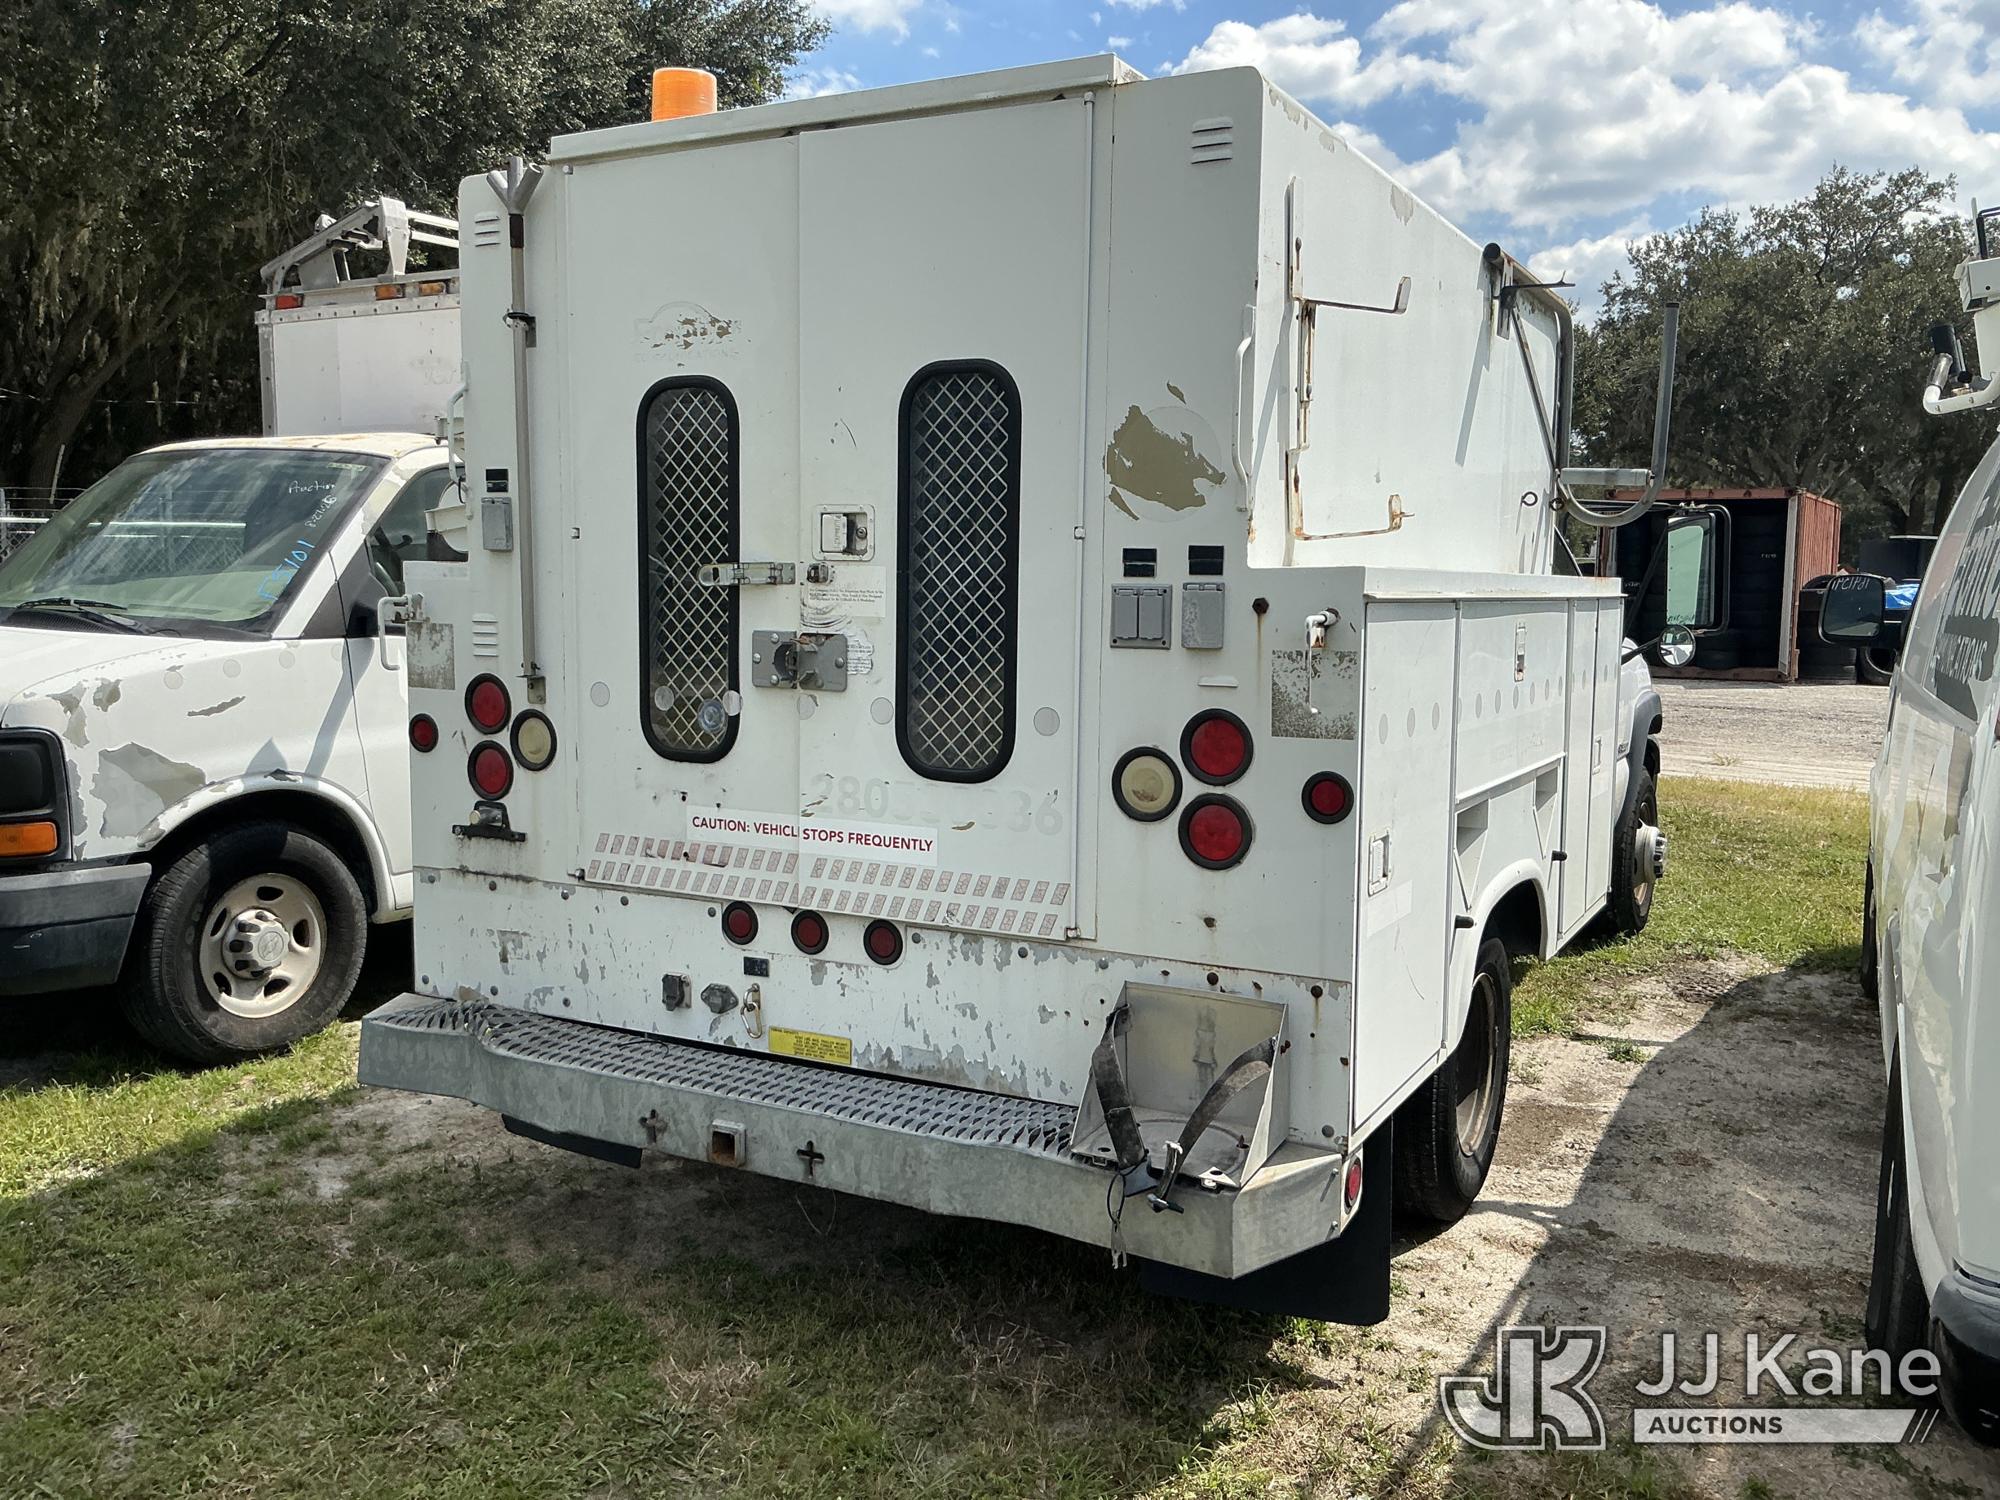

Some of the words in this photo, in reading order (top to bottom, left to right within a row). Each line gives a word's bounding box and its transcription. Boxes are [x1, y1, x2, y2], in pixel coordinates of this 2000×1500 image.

[692, 815, 751, 833] CAUTION:
[754, 821, 800, 838] VEHICL
[802, 828, 844, 844] STOPS
[847, 831, 934, 852] FREQUENTLY
